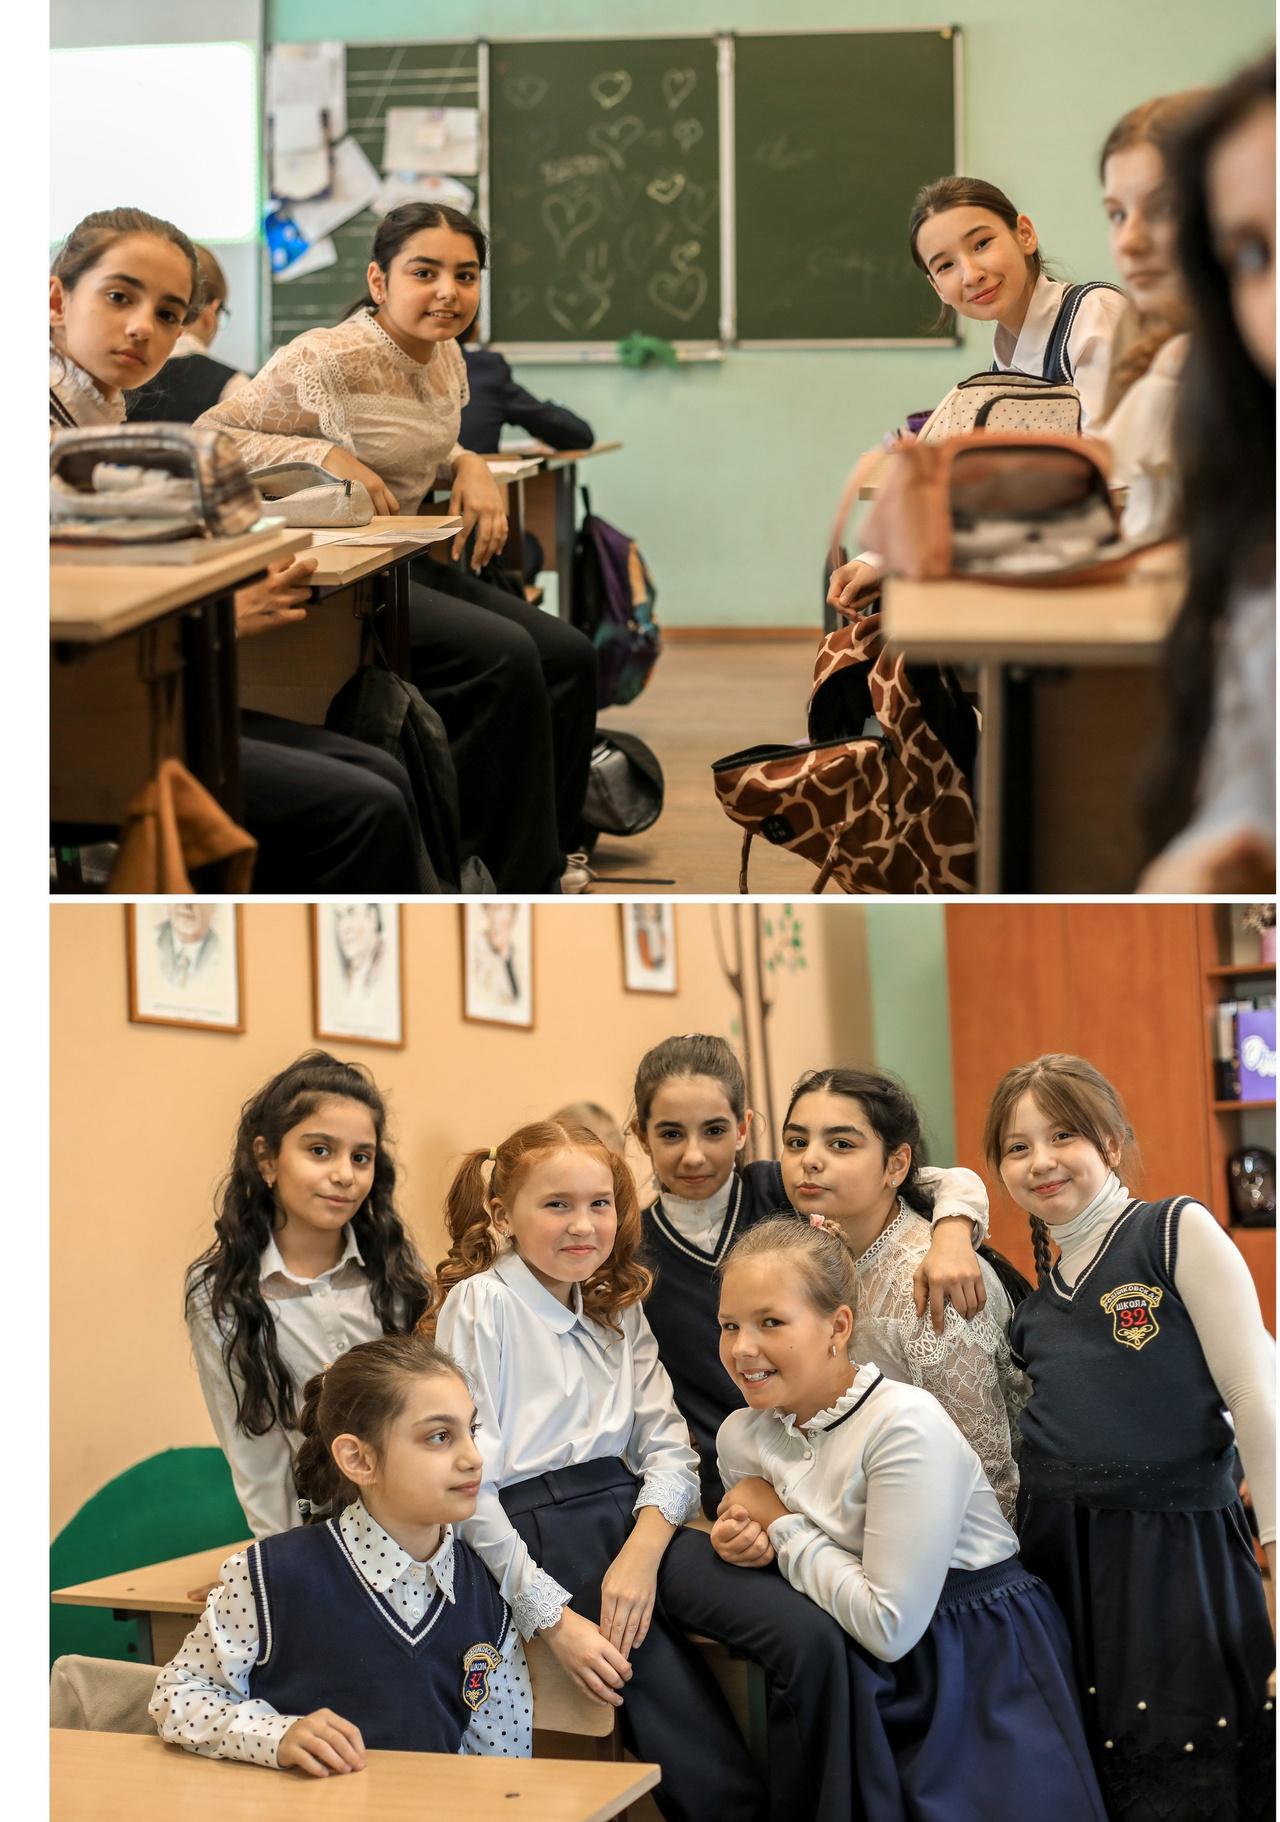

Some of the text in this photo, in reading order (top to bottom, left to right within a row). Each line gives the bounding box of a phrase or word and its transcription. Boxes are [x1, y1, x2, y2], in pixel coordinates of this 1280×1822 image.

[1104, 1285, 1159, 1307] РОДНИКОВСКАЯ
[1116, 1299, 1147, 1311] ШКОЛА
[1120, 1308, 1148, 1327] 32
[470, 1662, 487, 1671] ШКОЛА
[469, 1673, 482, 1688] 32
